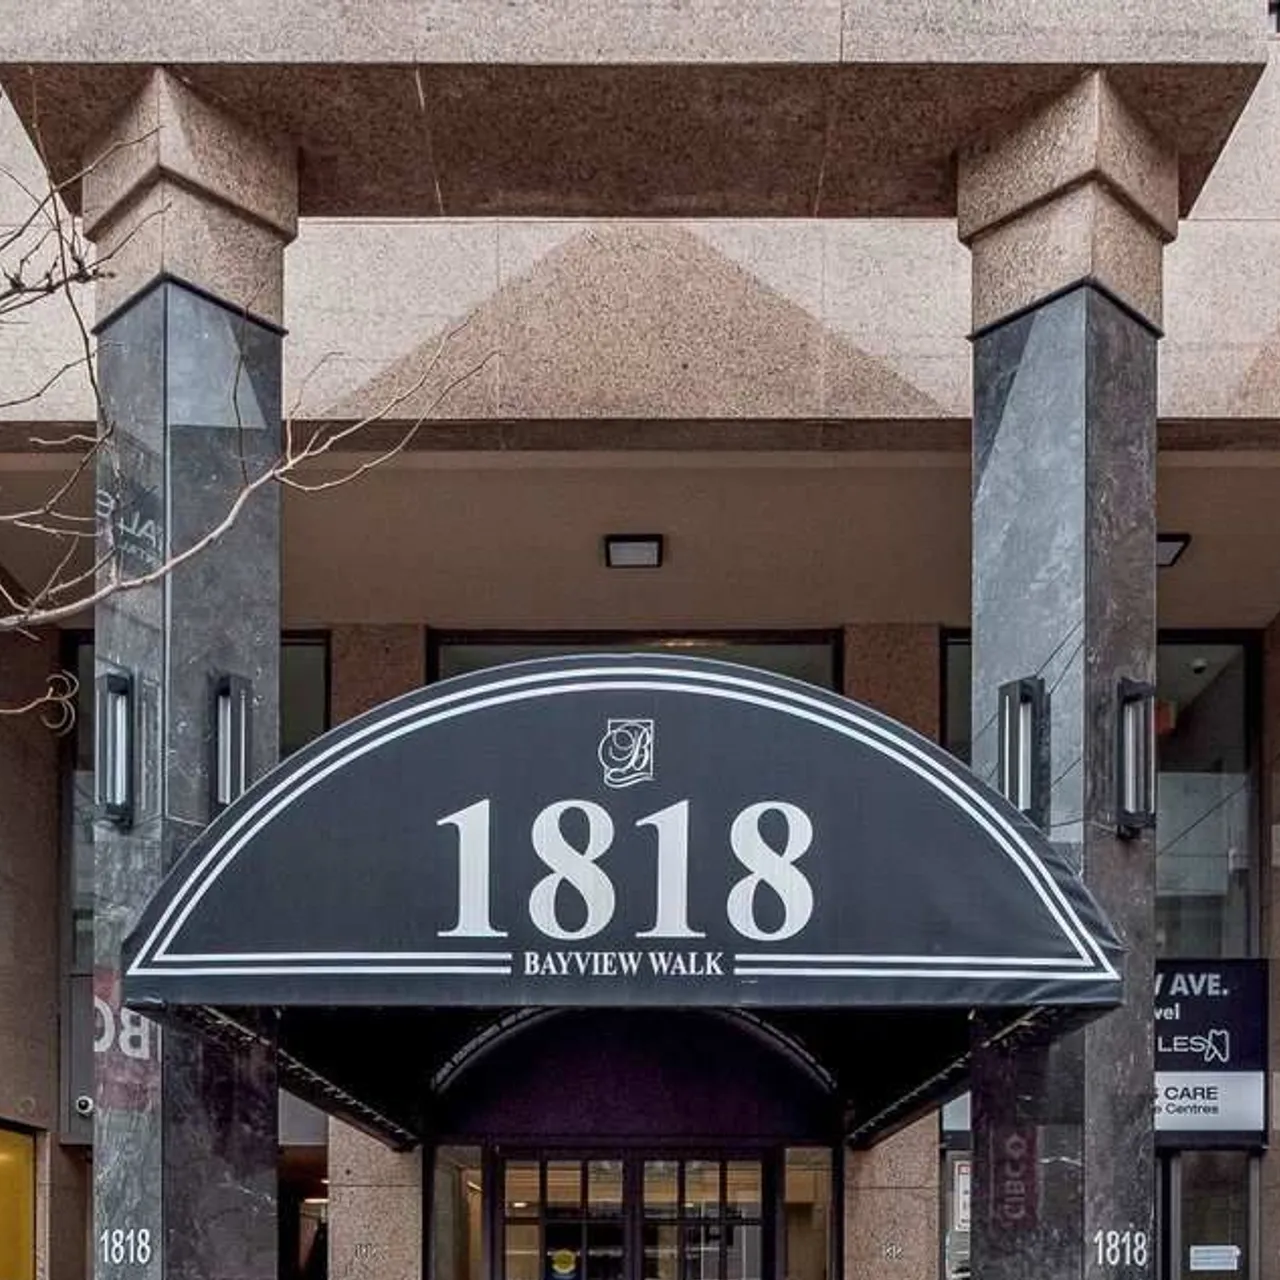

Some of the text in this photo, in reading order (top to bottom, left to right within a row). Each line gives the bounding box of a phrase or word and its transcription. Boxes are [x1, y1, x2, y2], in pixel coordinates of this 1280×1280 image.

[436, 799, 814, 942] 1818
[524, 951, 726, 978] BAYVIEW WALK
[1170, 974, 1229, 996] AVE.
[1164, 1086, 1219, 1101] CARE
[1166, 1103, 1219, 1115] Centres
[101, 1228, 152, 1264] 1818
[1095, 1229, 1146, 1266] 1818
